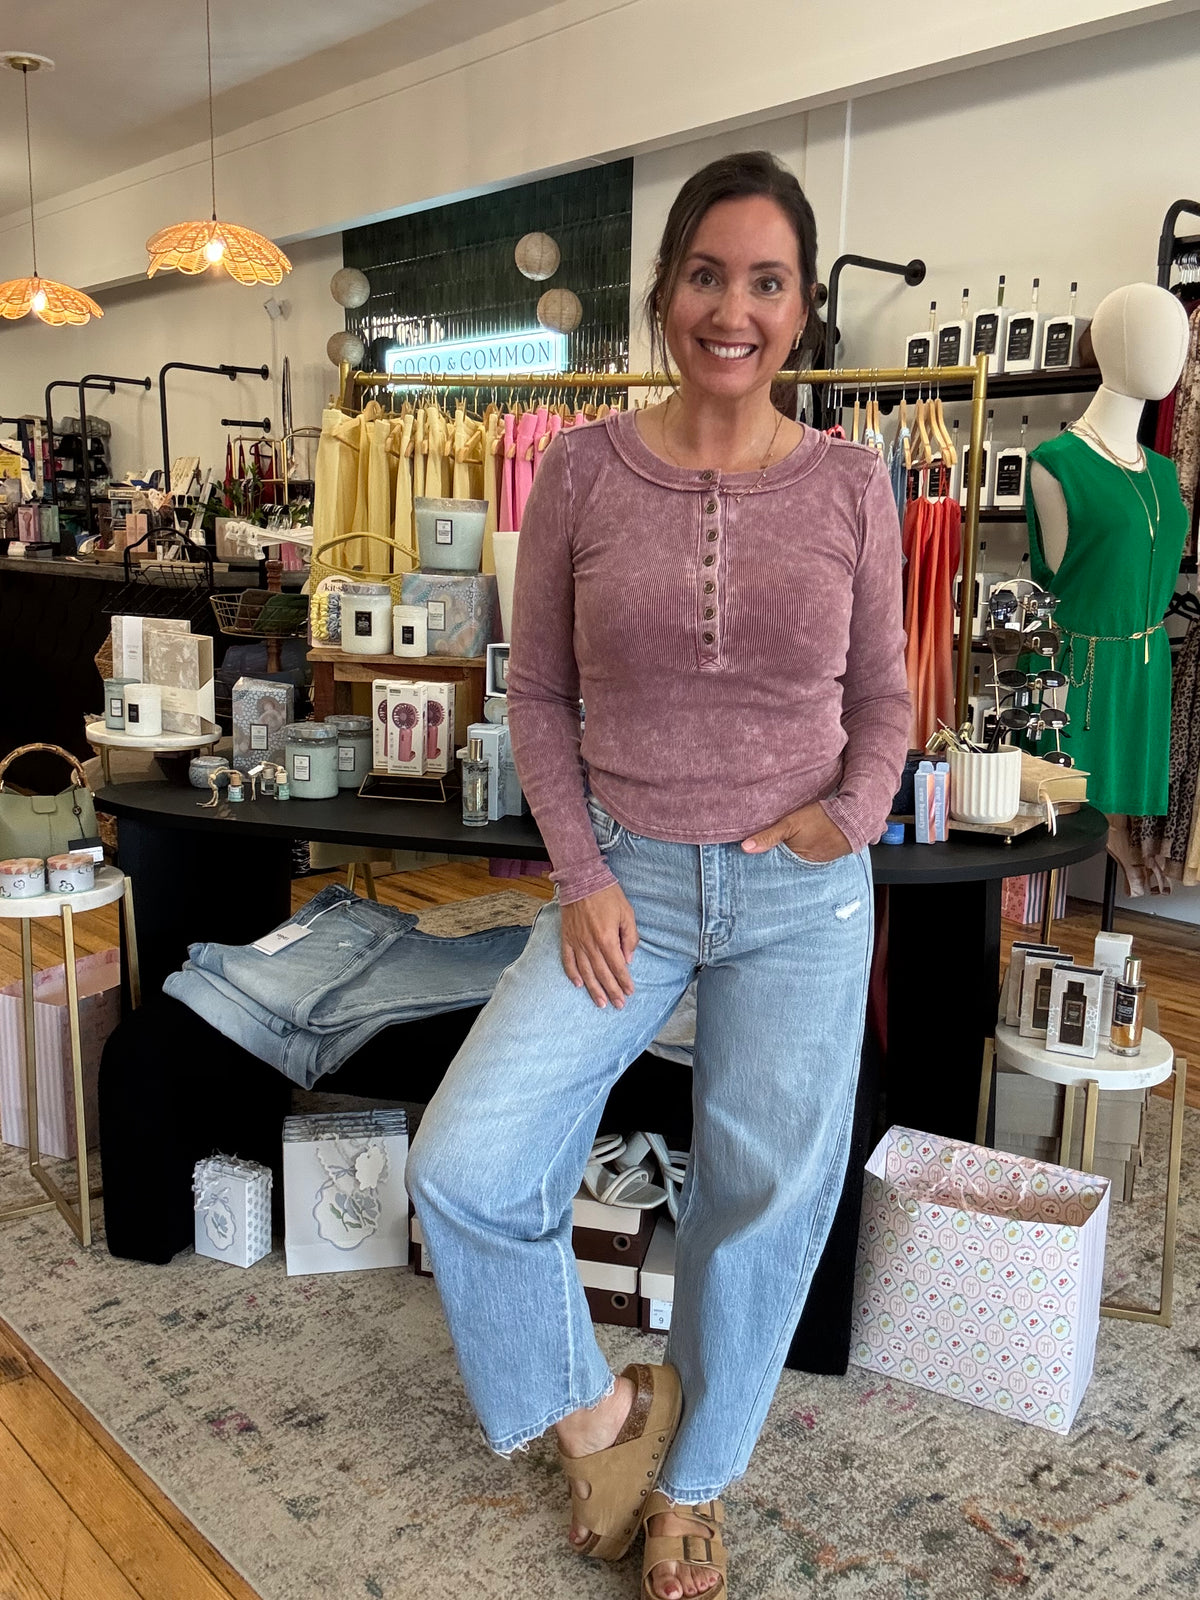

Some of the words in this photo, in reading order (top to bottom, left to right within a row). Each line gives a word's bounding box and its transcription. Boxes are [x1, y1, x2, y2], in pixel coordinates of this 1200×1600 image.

[393, 355, 440, 374] COCO
[447, 357, 456, 371] &
[460, 341, 550, 371] COMMON
[658, 1316, 664, 1324] 9
